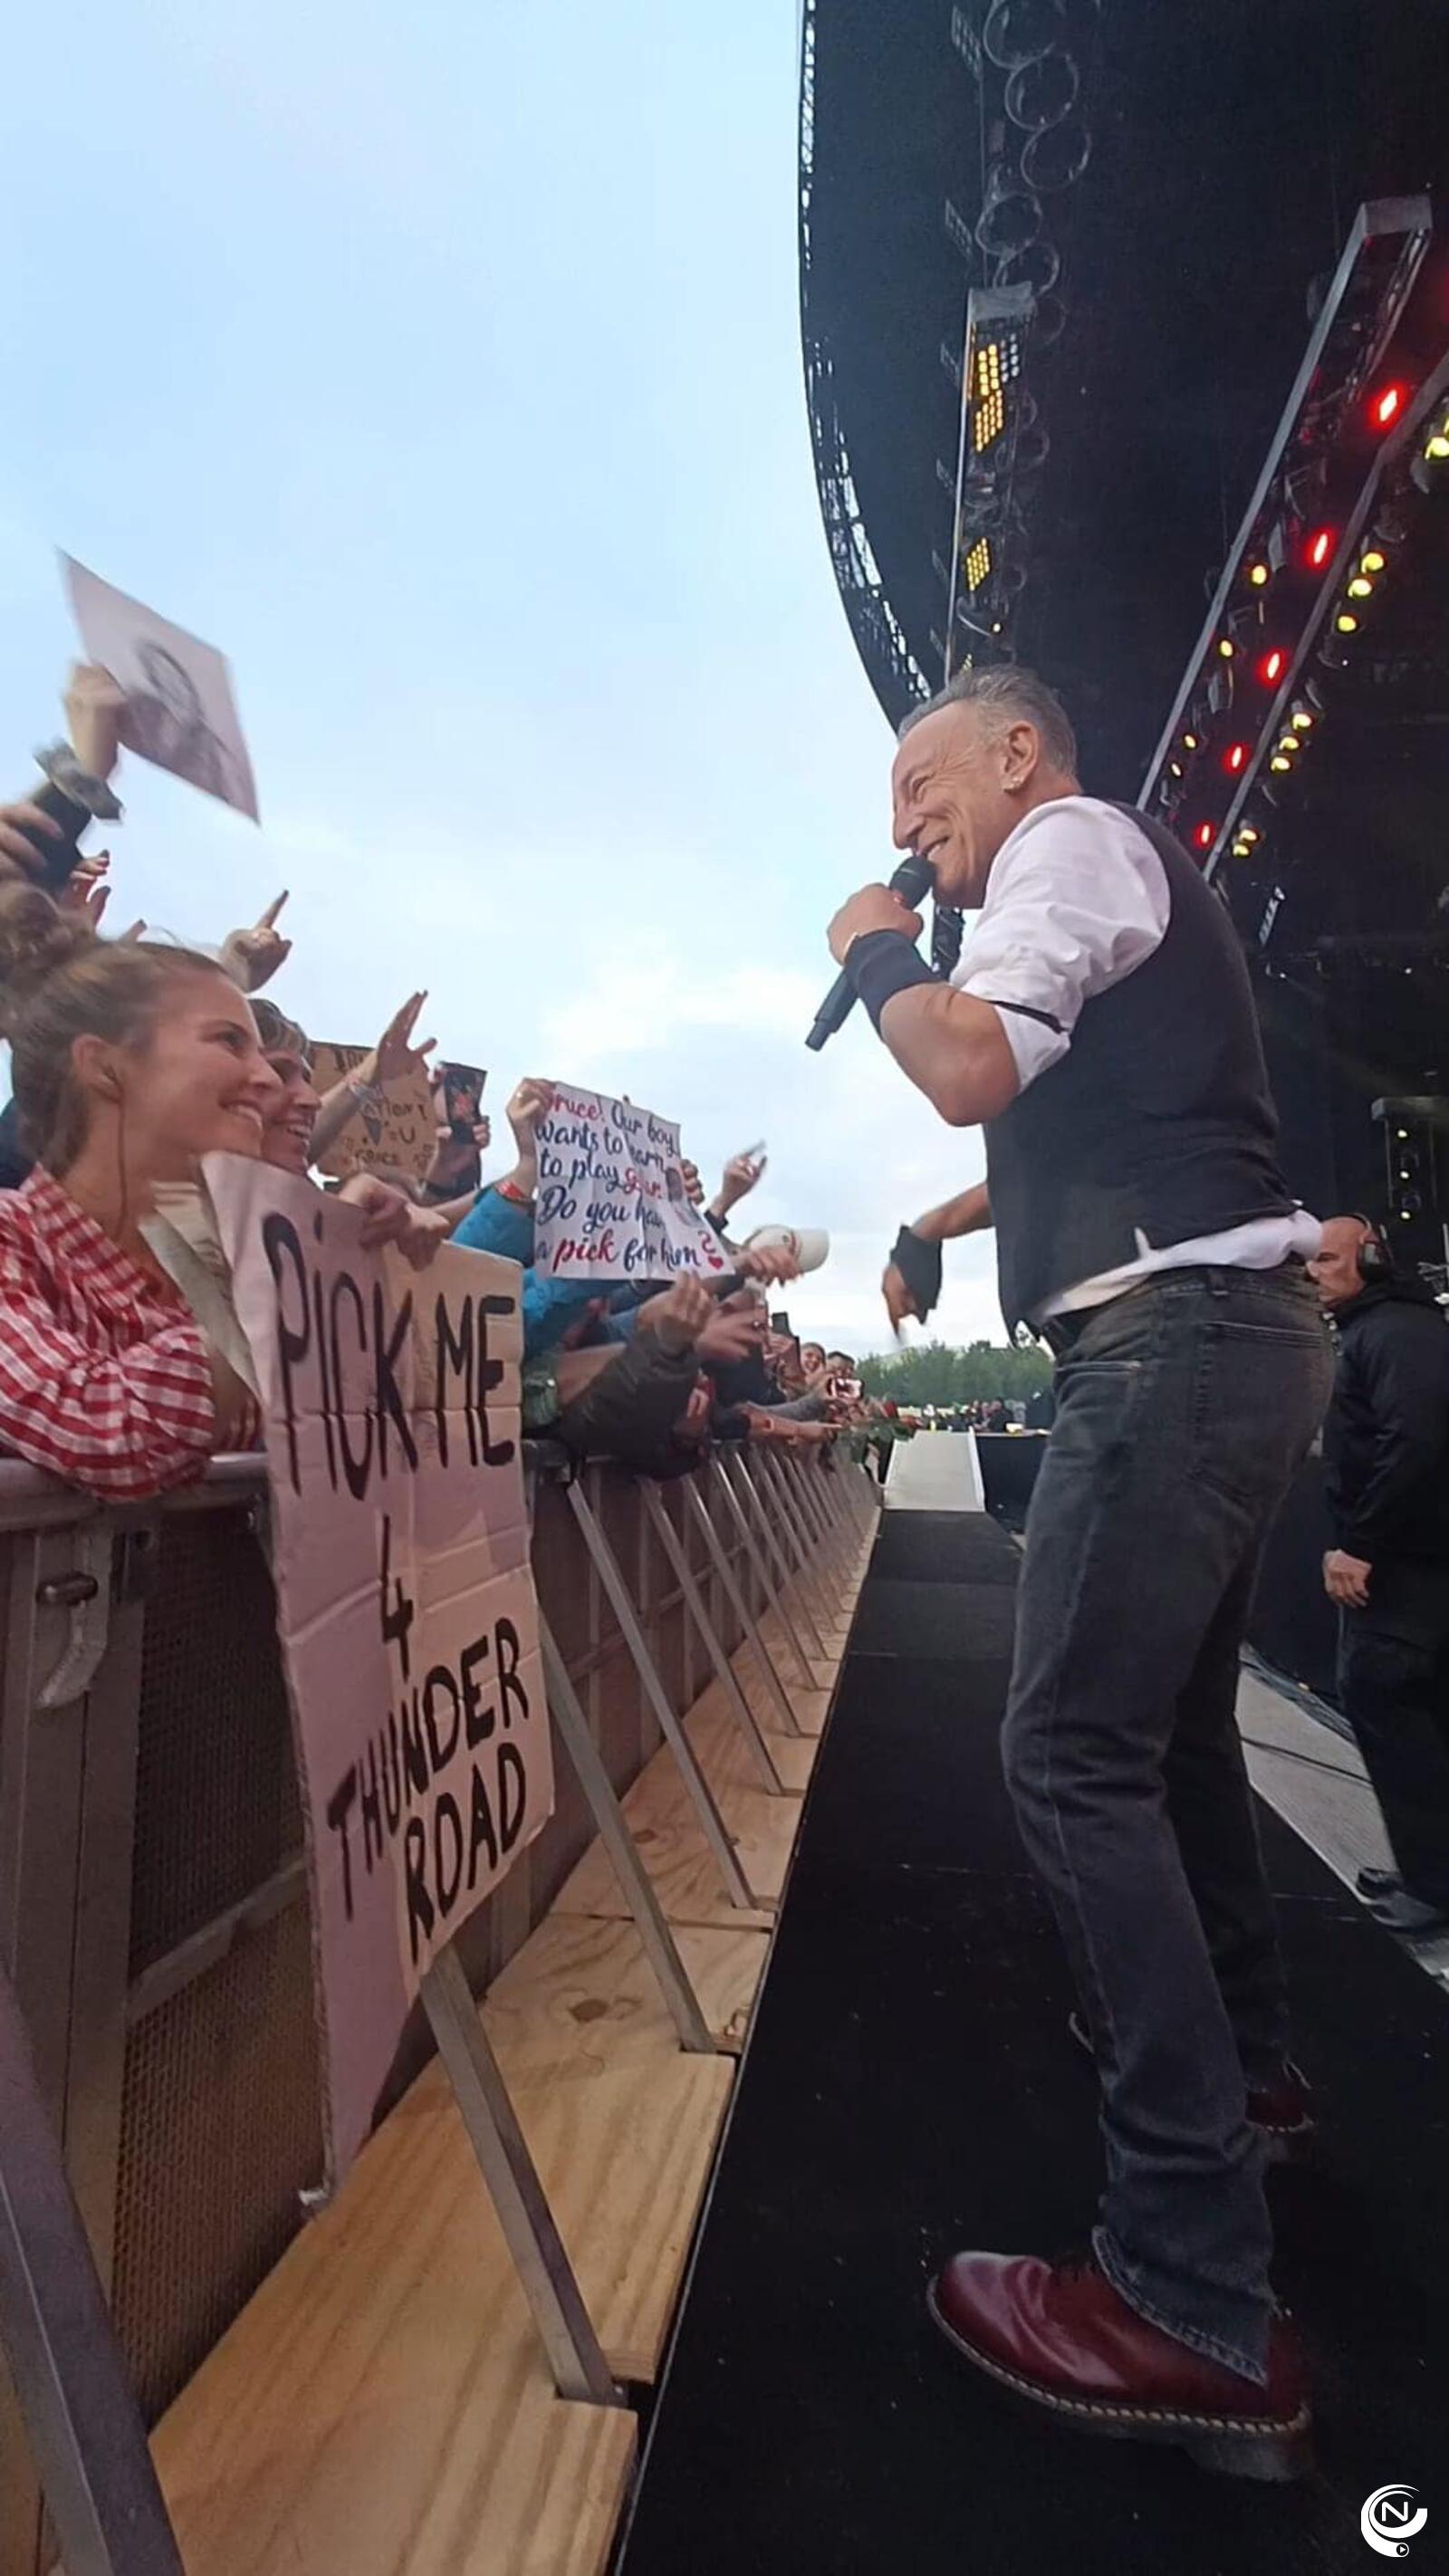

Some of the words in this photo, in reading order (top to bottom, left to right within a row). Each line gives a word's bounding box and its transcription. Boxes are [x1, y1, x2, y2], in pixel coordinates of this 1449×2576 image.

[536, 1120, 599, 1150] wants
[603, 1127, 623, 1155] to
[548, 1093, 605, 1122] ruce!
[611, 1101, 643, 1134] Our
[647, 1114, 681, 1158] boy
[541, 1148, 561, 1177] to
[569, 1149, 622, 1193] play
[537, 1185, 577, 1226] Do
[582, 1200, 631, 1235] you
[536, 1242, 551, 1262] a
[553, 1229, 619, 1271] pick
[624, 1238, 657, 1271] for
[435, 1293, 515, 1469] ME
[380, 1514, 413, 1685] 4
[327, 1616, 529, 1921] THUNDER
[405, 1741, 527, 1966] ROAD
